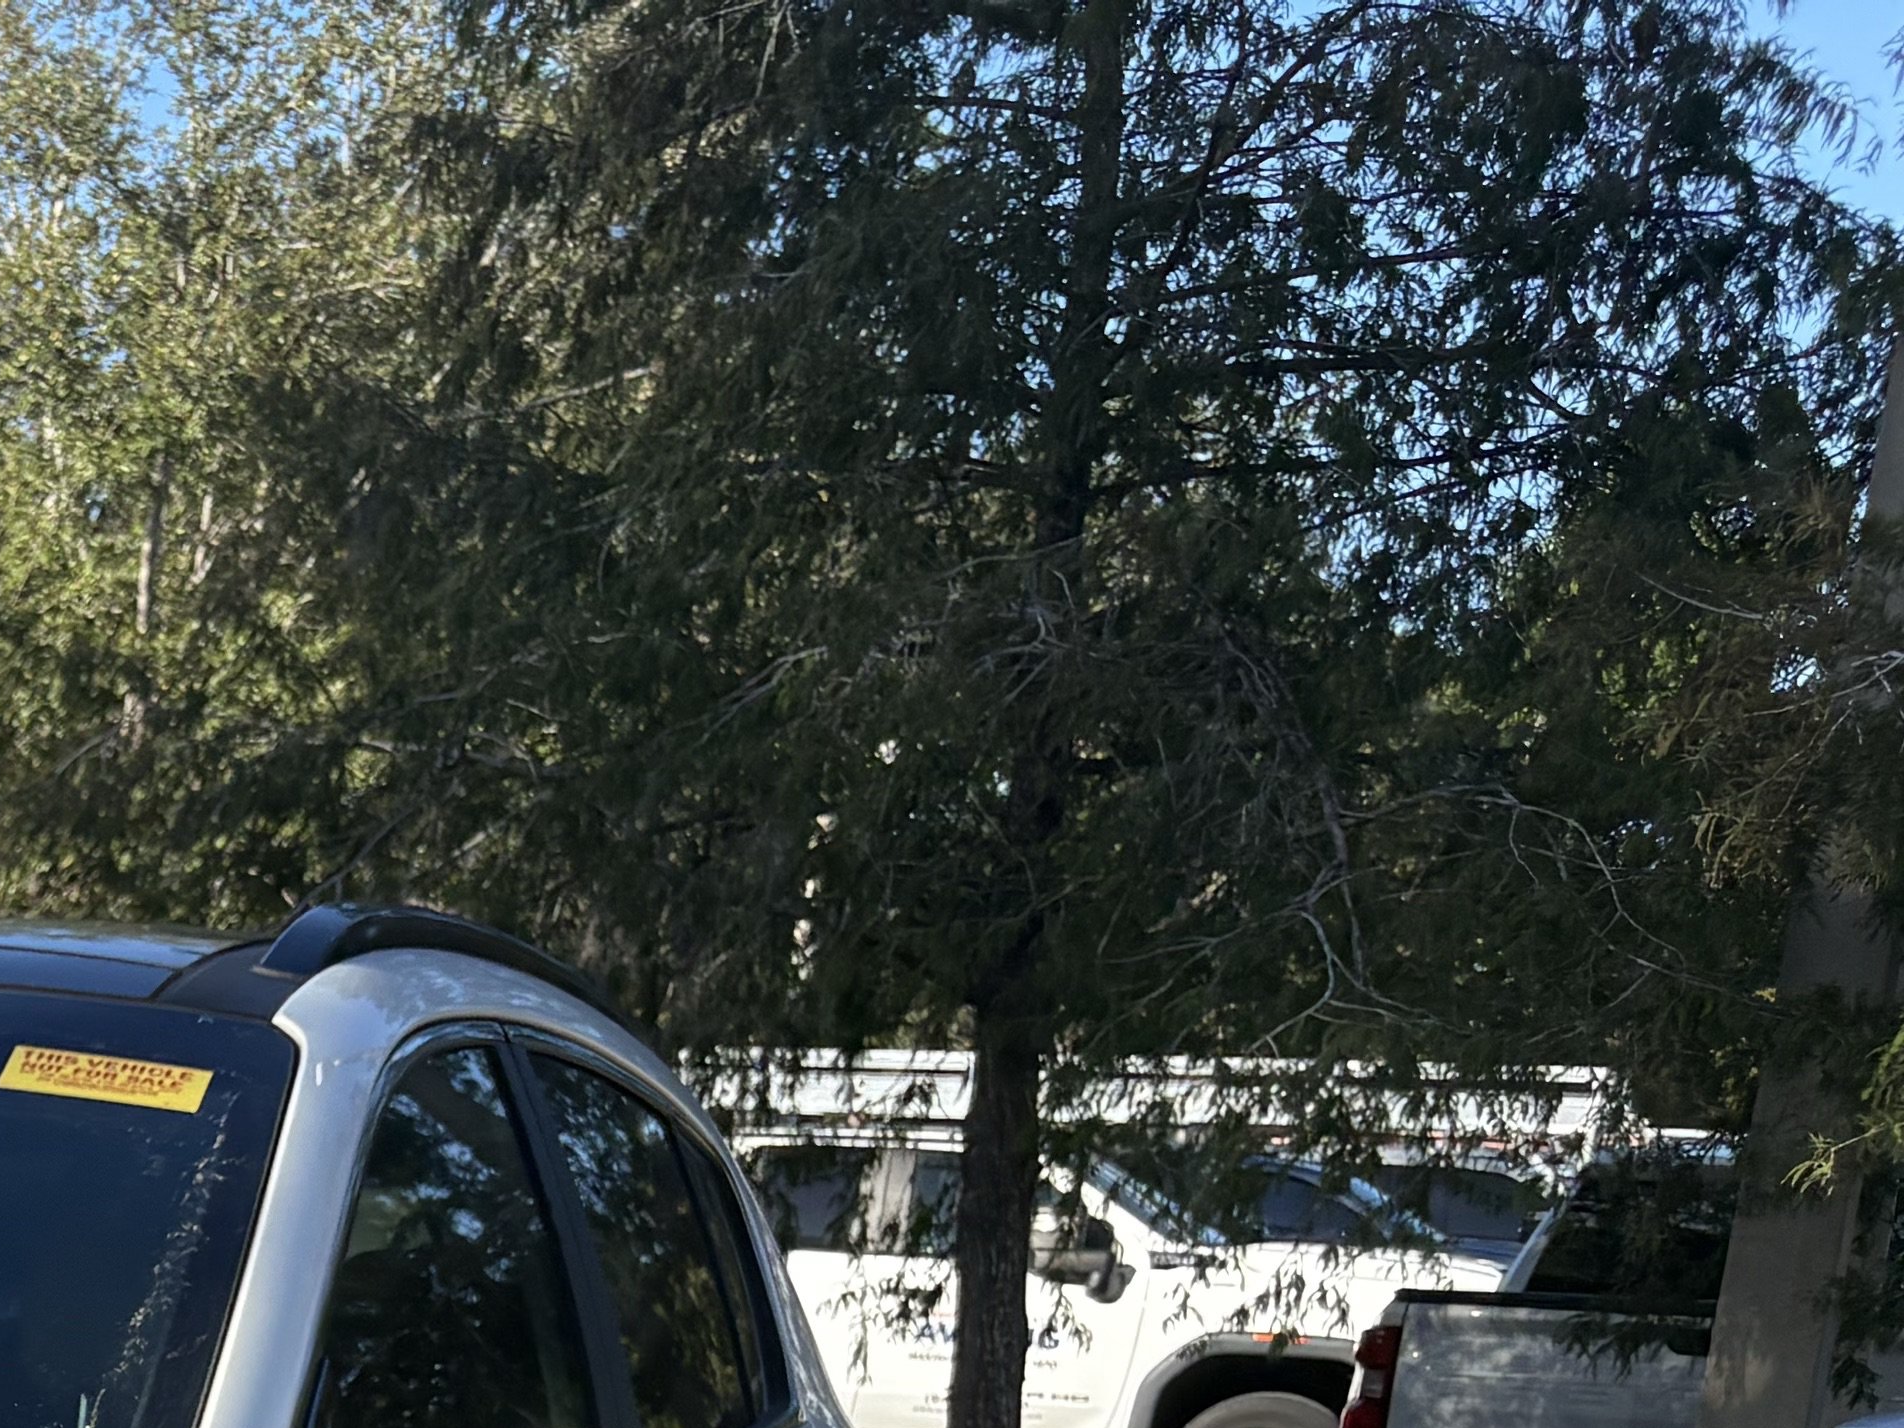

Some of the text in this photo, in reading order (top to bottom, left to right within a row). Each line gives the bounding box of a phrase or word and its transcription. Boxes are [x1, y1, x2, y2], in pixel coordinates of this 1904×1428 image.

[21, 1061, 63, 1075] NOT
[73, 1067, 118, 1081] FOR
[127, 1074, 185, 1091] SALE
[23, 1050, 195, 1082] THIS VEHICLE
